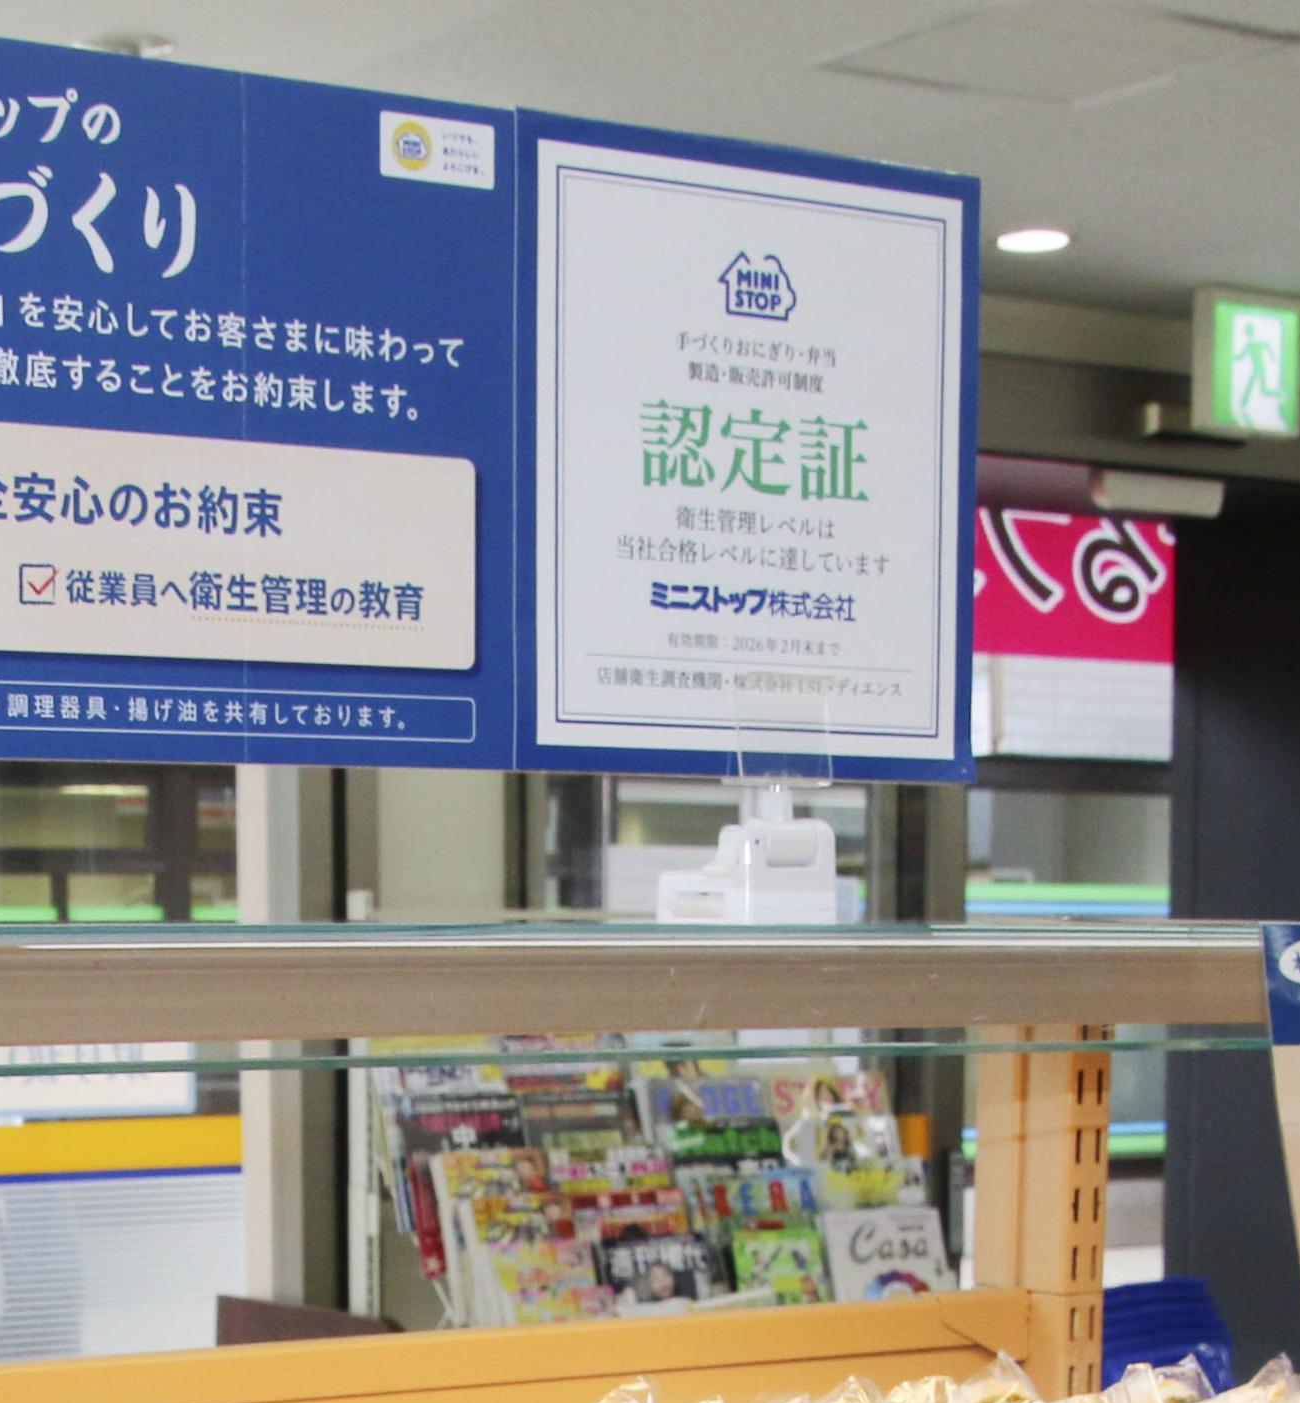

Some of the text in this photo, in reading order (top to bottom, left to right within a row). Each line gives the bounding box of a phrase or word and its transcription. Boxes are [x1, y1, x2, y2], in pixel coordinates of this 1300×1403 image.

[737, 268, 779, 290] MINI
[735, 289, 781, 311] STOP
[640, 399, 869, 501] 認定証
[676, 505, 835, 539] 衛生管理レベルは
[616, 535, 890, 576] 当社合格レベルに達しています
[65, 570, 425, 621] 従業員へ衛生管理の教育
[650, 581, 856, 623] ミニストップ株式会社
